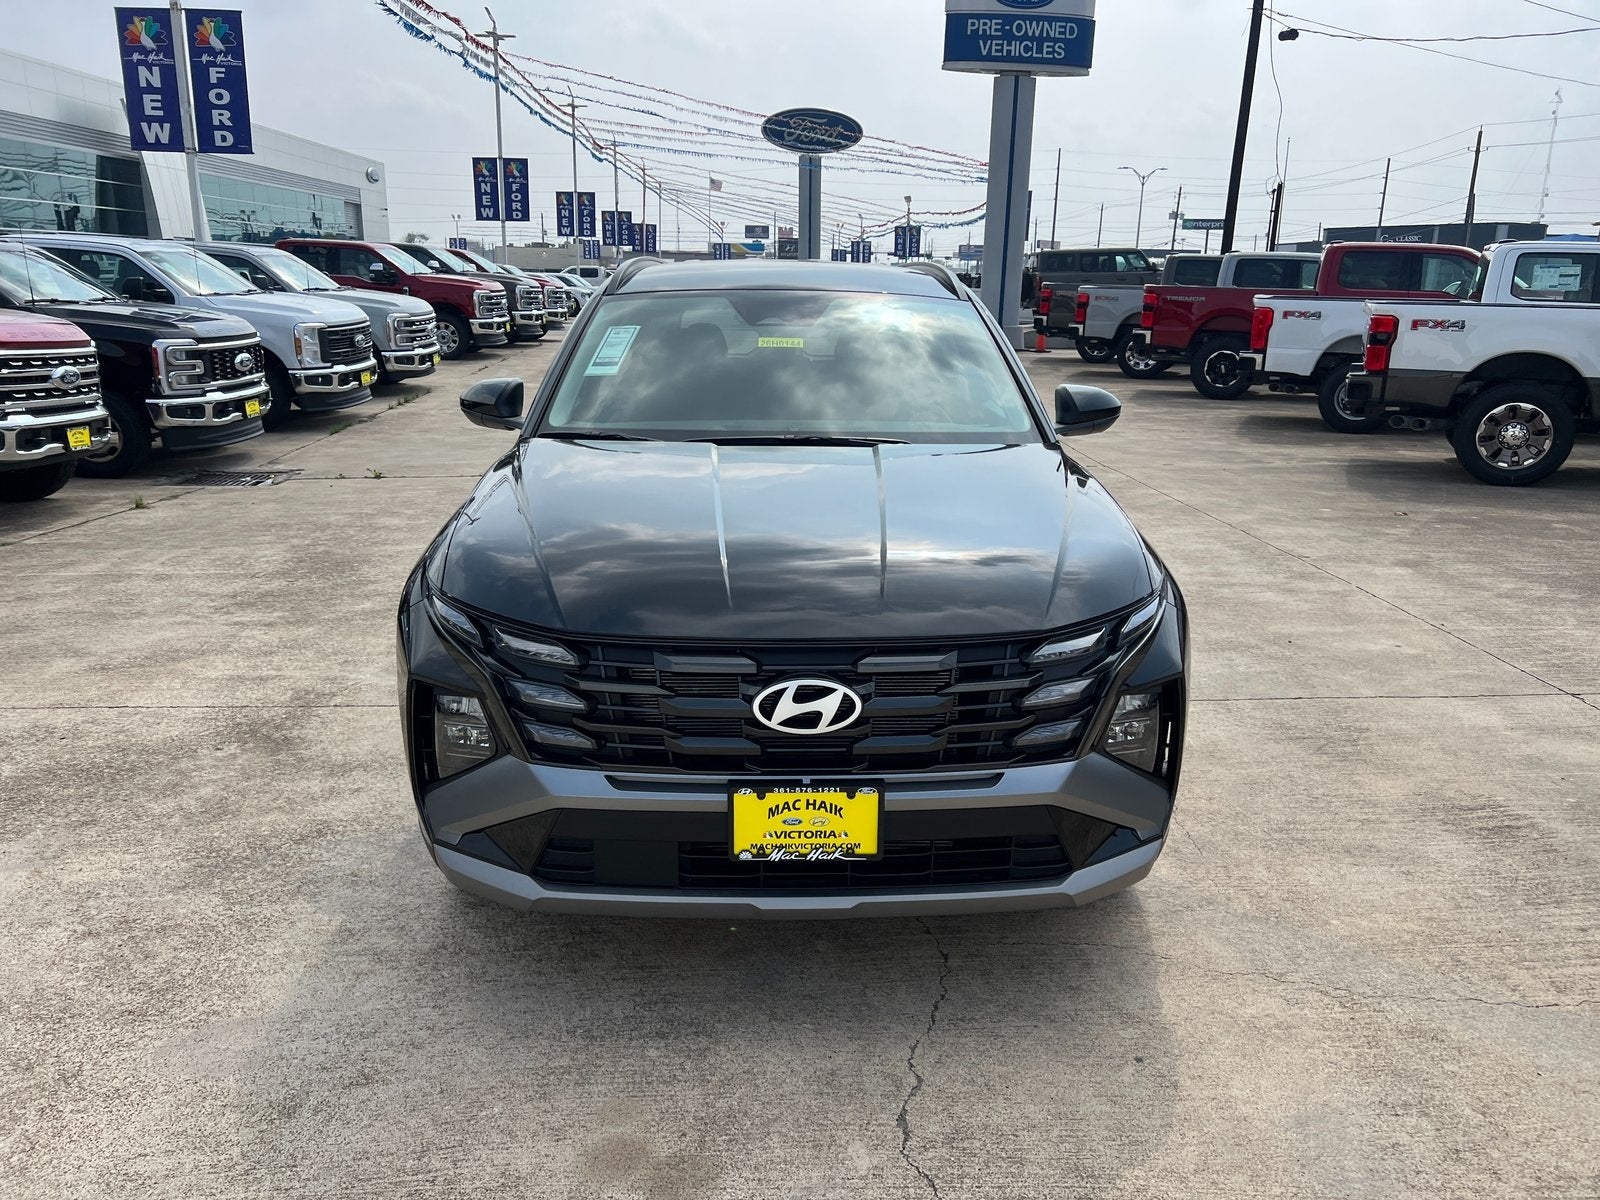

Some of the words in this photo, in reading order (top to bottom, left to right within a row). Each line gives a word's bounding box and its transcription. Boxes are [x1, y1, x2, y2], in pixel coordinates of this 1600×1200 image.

[967, 19, 1078, 38] PRE-OWNED
[979, 40, 1065, 59] VEHICLES
[138, 66, 171, 144] NEW
[208, 67, 234, 147] FORD
[784, 116, 843, 142] Ford
[480, 183, 494, 218] NEW
[511, 184, 522, 219] FORD
[561, 209, 571, 235] NEW
[583, 210, 591, 236] FORD
[605, 224, 614, 244] NEW
[1166, 295, 1206, 303] TREMOR
[1282, 310, 1322, 319] FX4
[1410, 319, 1466, 331] FX4
[768, 799, 801, 819] MAC
[805, 798, 844, 819] HAIK
[774, 830, 837, 839] VICTORIA
[767, 848, 805, 861] Mac
[805, 847, 844, 861] Haik
